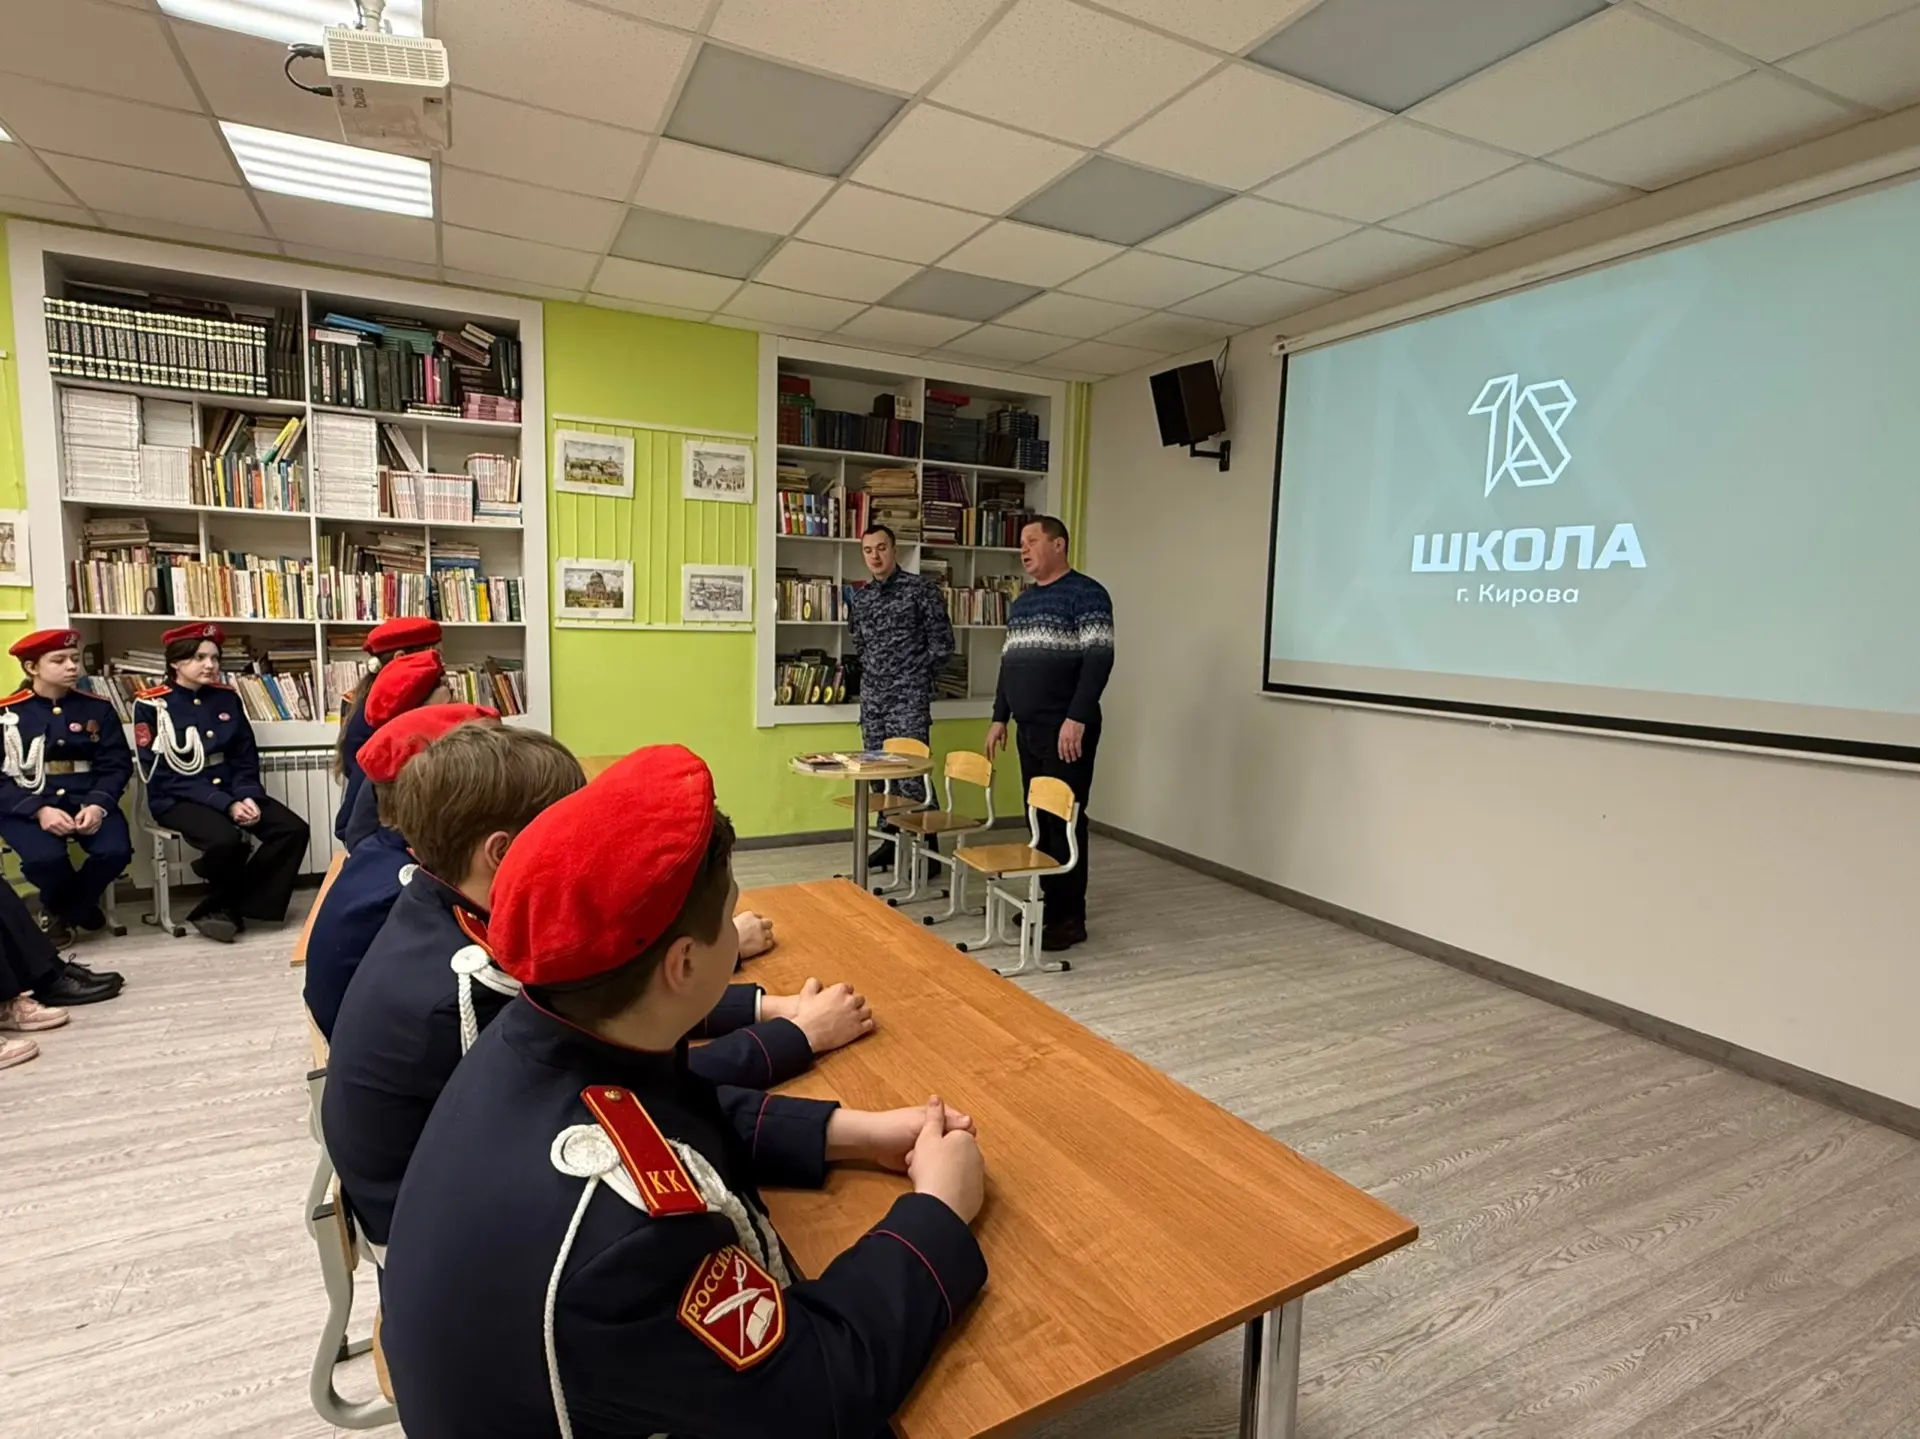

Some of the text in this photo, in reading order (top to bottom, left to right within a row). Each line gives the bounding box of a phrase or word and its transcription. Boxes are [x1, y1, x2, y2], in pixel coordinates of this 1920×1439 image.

[1411, 523, 1647, 572] ШКОЛА
[1456, 583, 1580, 608] г. Кирова
[645, 1169, 688, 1194] КК
